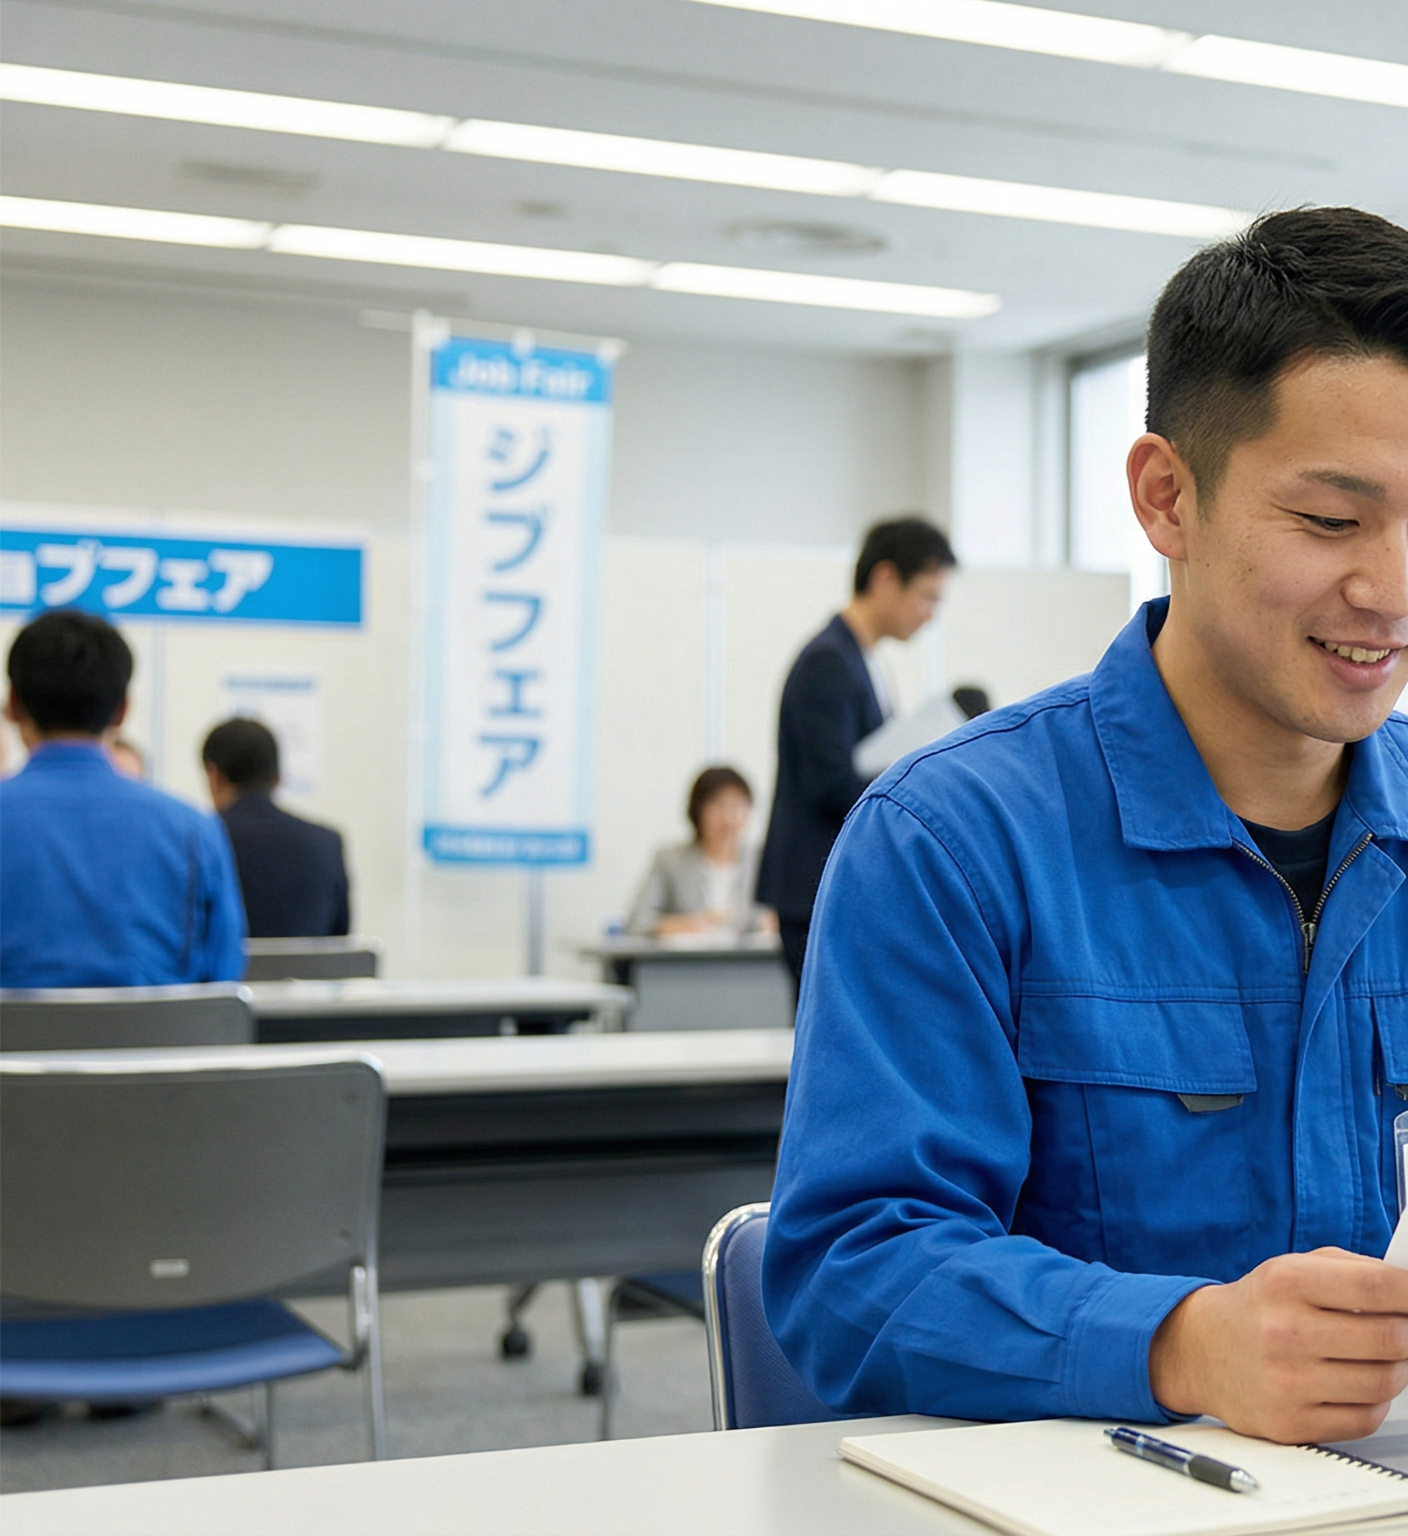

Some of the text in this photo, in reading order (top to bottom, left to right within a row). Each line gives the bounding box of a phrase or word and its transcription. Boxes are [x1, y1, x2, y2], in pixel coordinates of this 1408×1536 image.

[480, 426, 551, 796] ジブフェア
